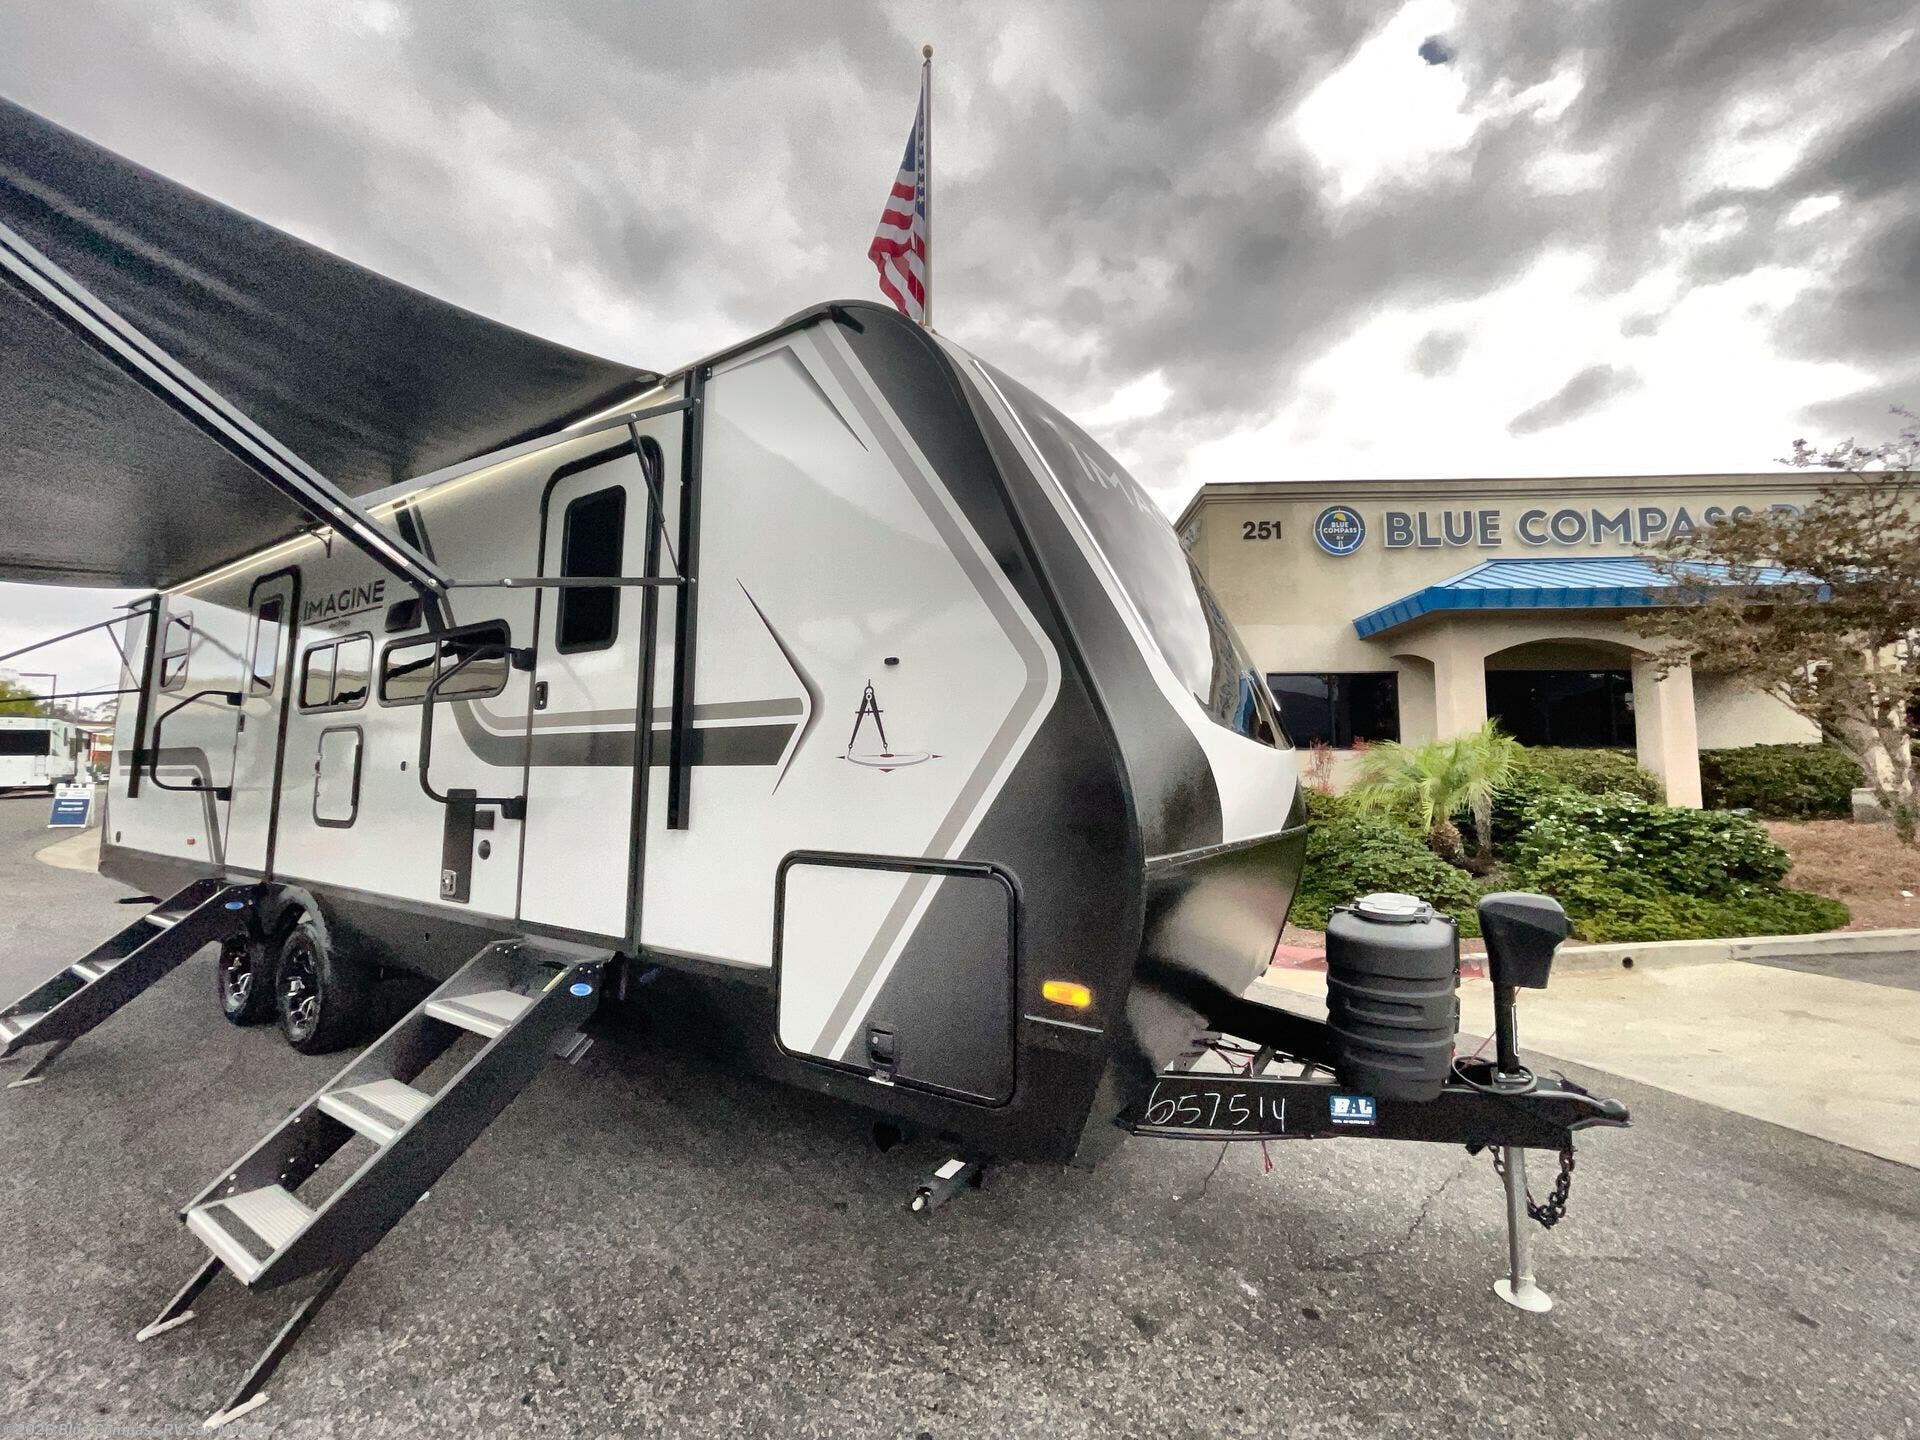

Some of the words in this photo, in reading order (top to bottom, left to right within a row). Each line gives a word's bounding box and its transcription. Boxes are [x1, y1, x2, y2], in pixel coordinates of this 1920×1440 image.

[1243, 521, 1281, 540] 251
[1385, 510, 1502, 547] BLUE
[303, 579, 386, 622] IMAGINE
[1145, 1081, 1286, 1132] 657514
[1333, 1098, 1373, 1114] BAL
